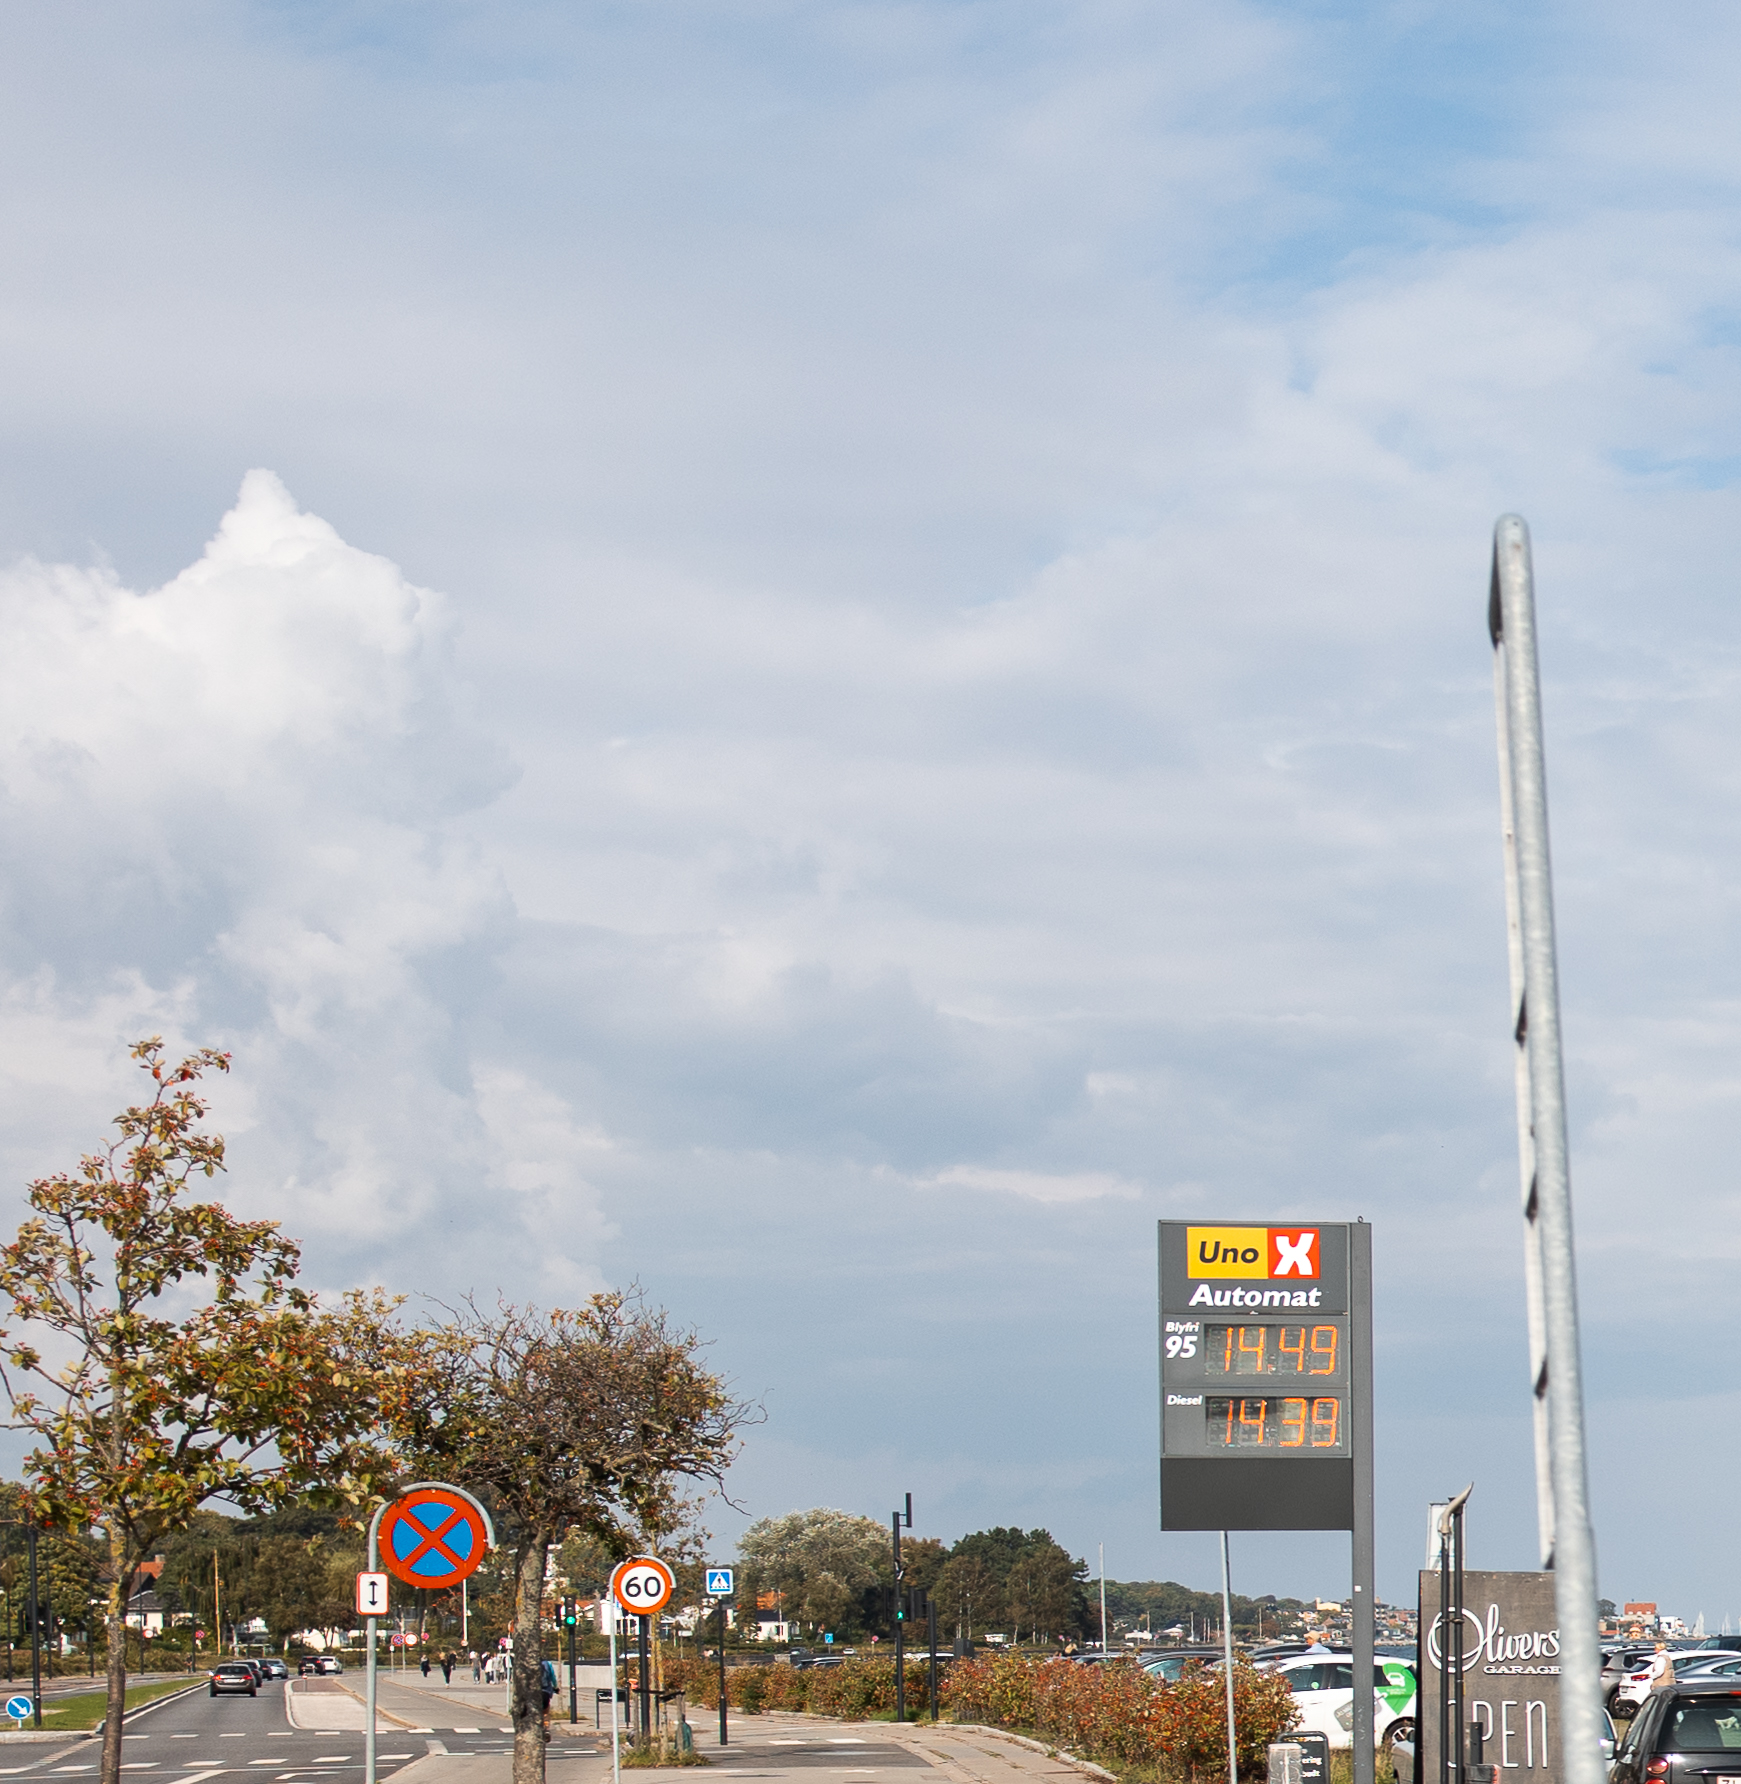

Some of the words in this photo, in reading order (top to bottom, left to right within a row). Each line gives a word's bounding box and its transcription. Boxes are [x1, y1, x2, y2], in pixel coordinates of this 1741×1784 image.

[1199, 1241, 1259, 1264] Uno
[1274, 1233, 1315, 1275] X
[1188, 1284, 1322, 1307] Automat
[1165, 1322, 1200, 1334] Blyfri
[1165, 1336, 1198, 1359] 95
[1167, 1395, 1203, 1405] Diesel
[625, 1576, 662, 1597] 60
[1427, 1603, 1561, 1674] Olivers
[1483, 1665, 1563, 1675] GARAGE
